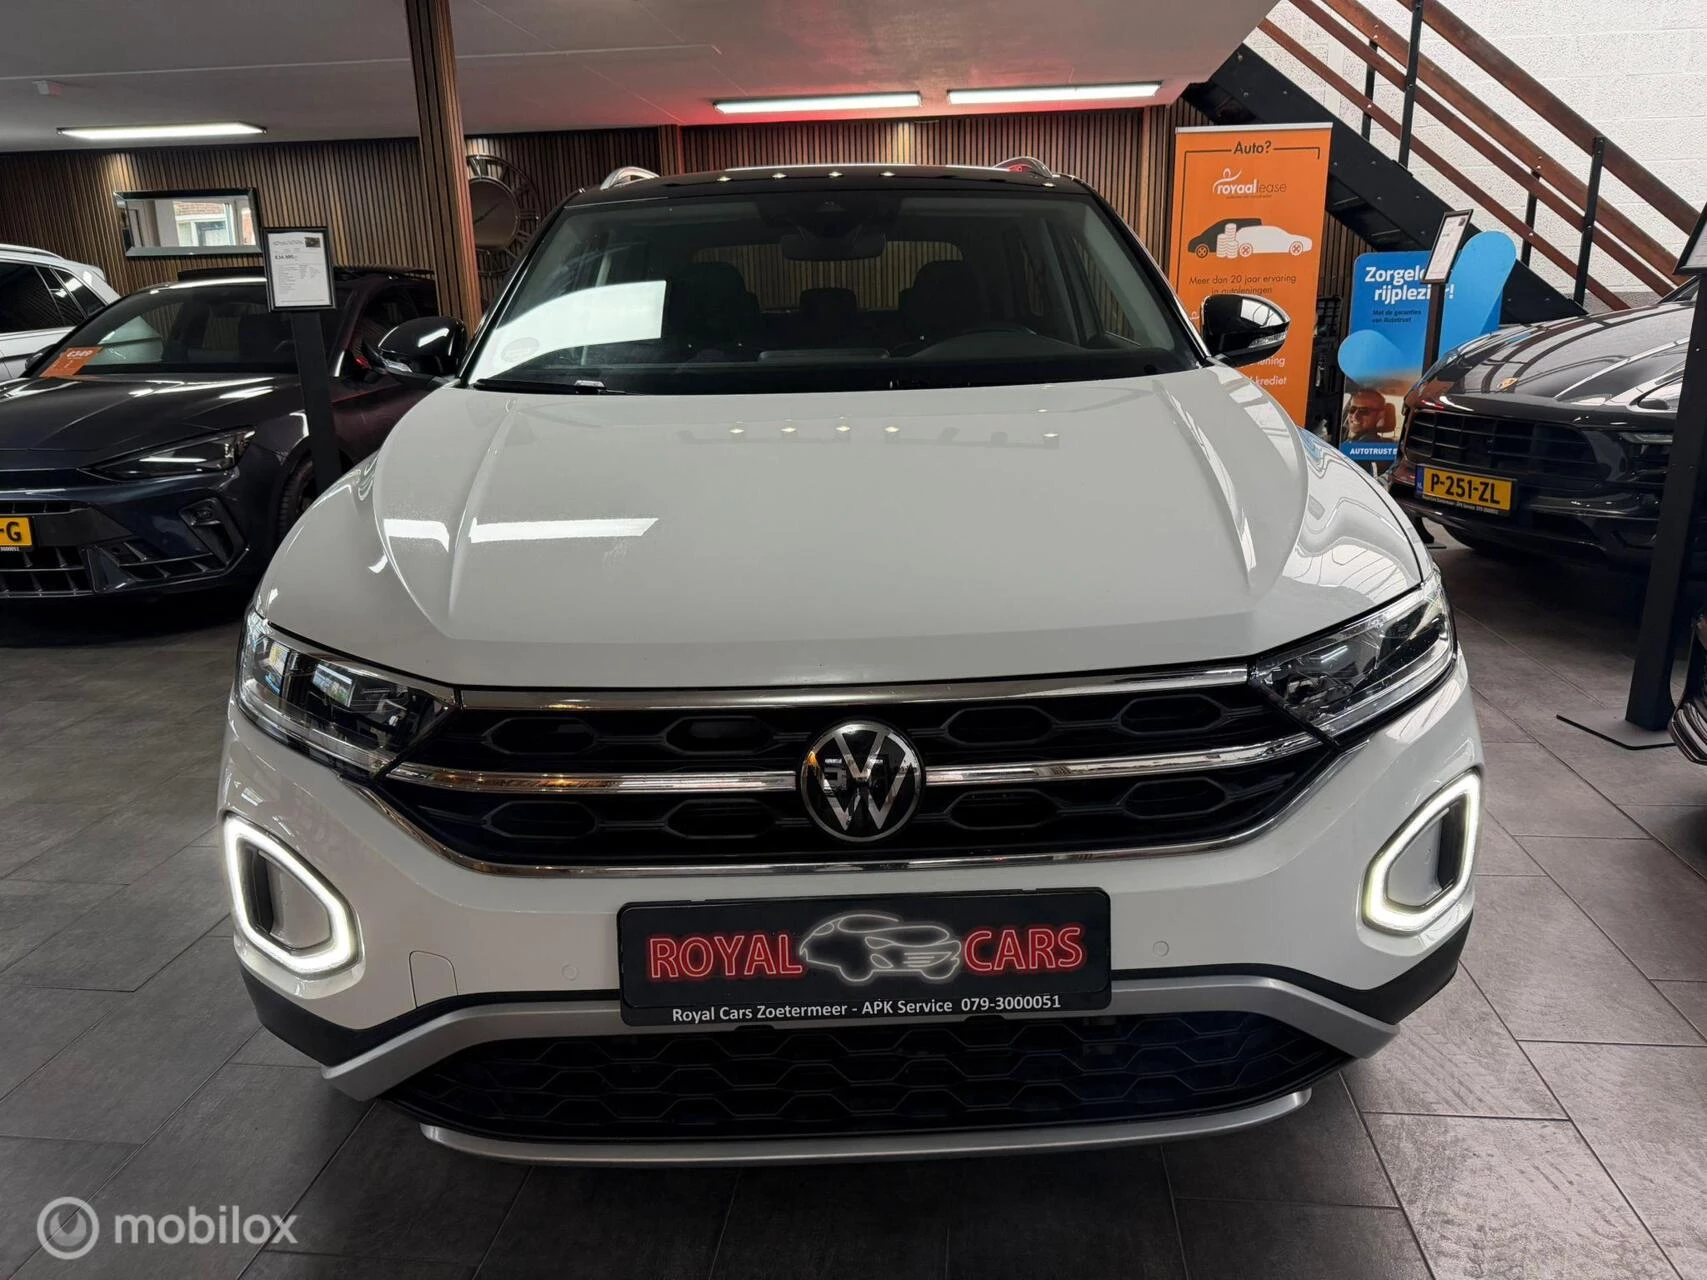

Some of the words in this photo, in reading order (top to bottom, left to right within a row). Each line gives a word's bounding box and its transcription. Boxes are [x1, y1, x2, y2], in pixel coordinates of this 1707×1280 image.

[1233, 140, 1272, 155] Auto?
[1189, 276, 1209, 285] Meer
[1212, 275, 1228, 285] dan
[1231, 274, 1242, 284] 20
[1244, 275, 1261, 286] jaar
[1262, 273, 1297, 284] ervaring
[1374, 284, 1454, 304] rijplezi!
[1430, 472, 1501, 505] P-251-ZL
[649, 933, 804, 979] ROYAL
[964, 926, 1084, 971] CARS
[672, 1006, 715, 1024] Royal
[719, 1006, 752, 1020] Cars
[757, 1004, 848, 1019] Zoetermeer
[862, 1001, 894, 1015] APK
[897, 999, 952, 1014] Service
[961, 995, 1062, 1012] 079-3000051
